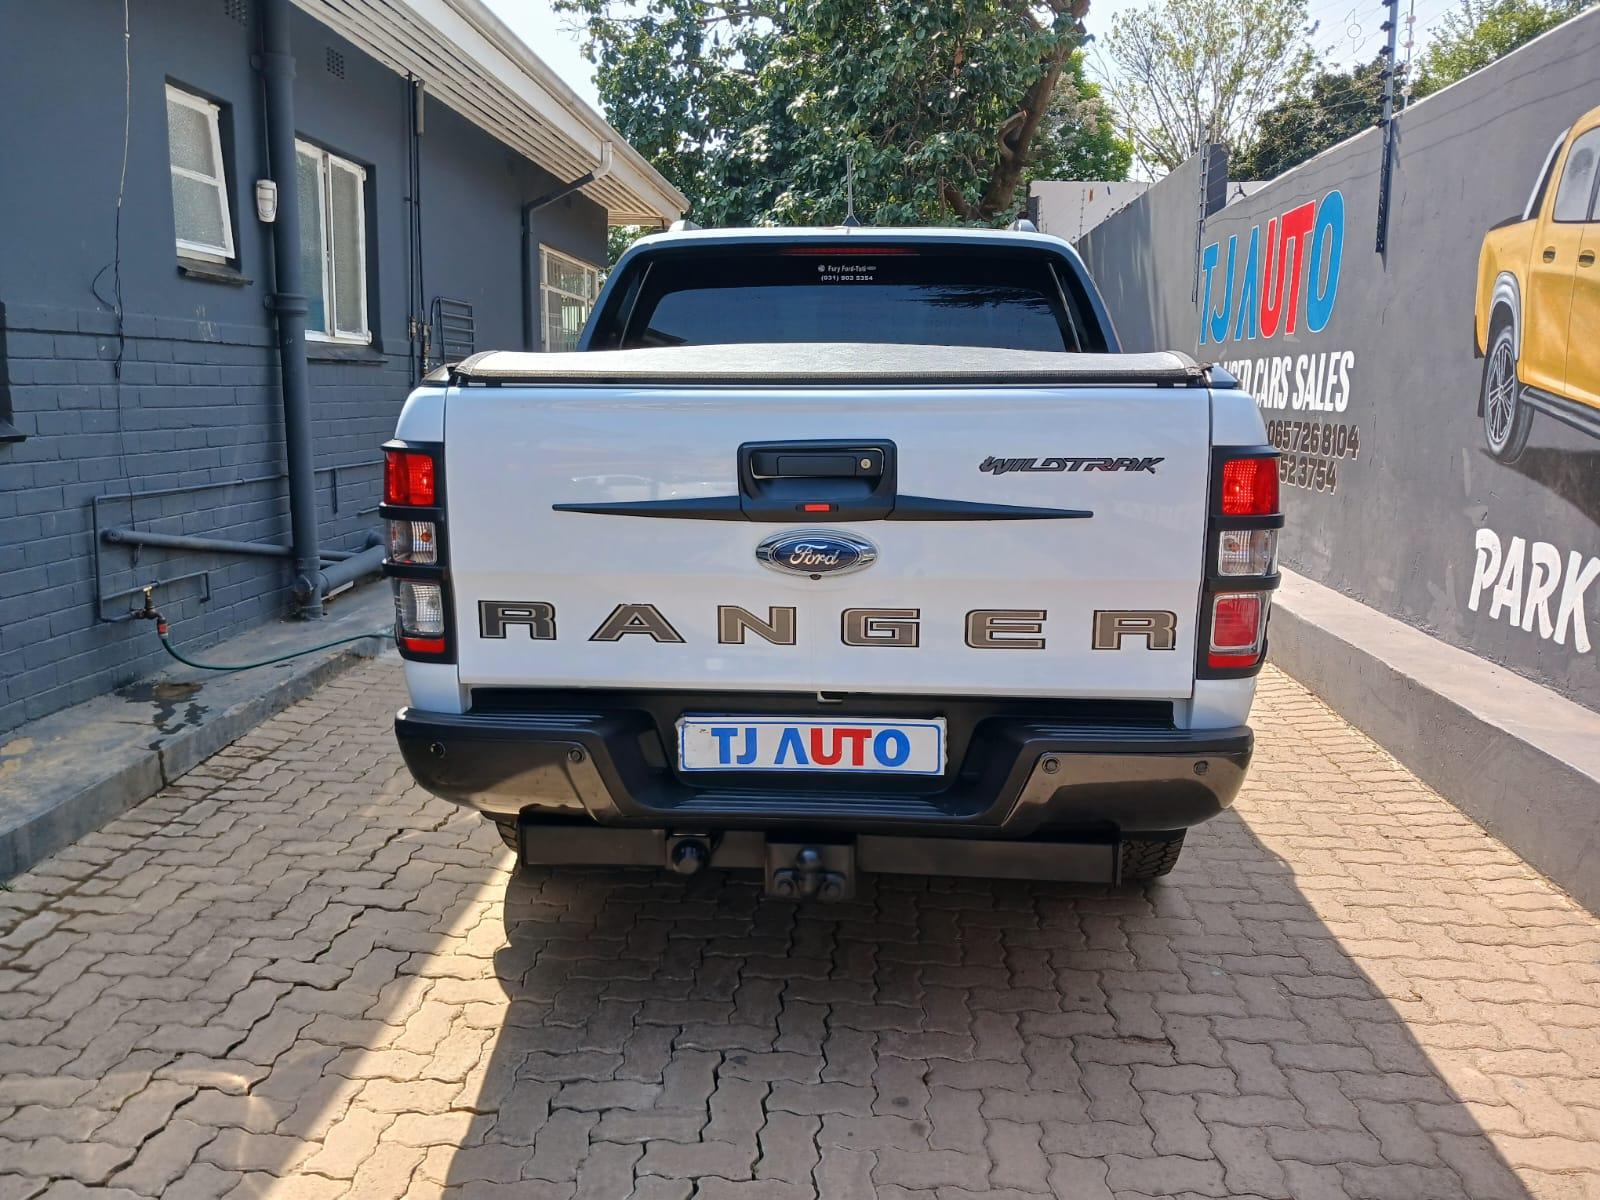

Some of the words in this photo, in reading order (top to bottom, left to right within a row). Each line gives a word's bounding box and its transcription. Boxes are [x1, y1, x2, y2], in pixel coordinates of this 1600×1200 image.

[1199, 234, 1238, 345] TJ
[1234, 189, 1345, 341] AUTO
[1253, 356, 1292, 410] CARS
[1292, 350, 1355, 412] SALES
[978, 456, 1166, 475] WILDTRAK
[789, 543, 841, 565] Ford
[1468, 528, 1600, 653] PARK
[478, 600, 1178, 651] RANGER
[711, 727, 758, 765] TJ
[773, 727, 910, 768] AUTO
